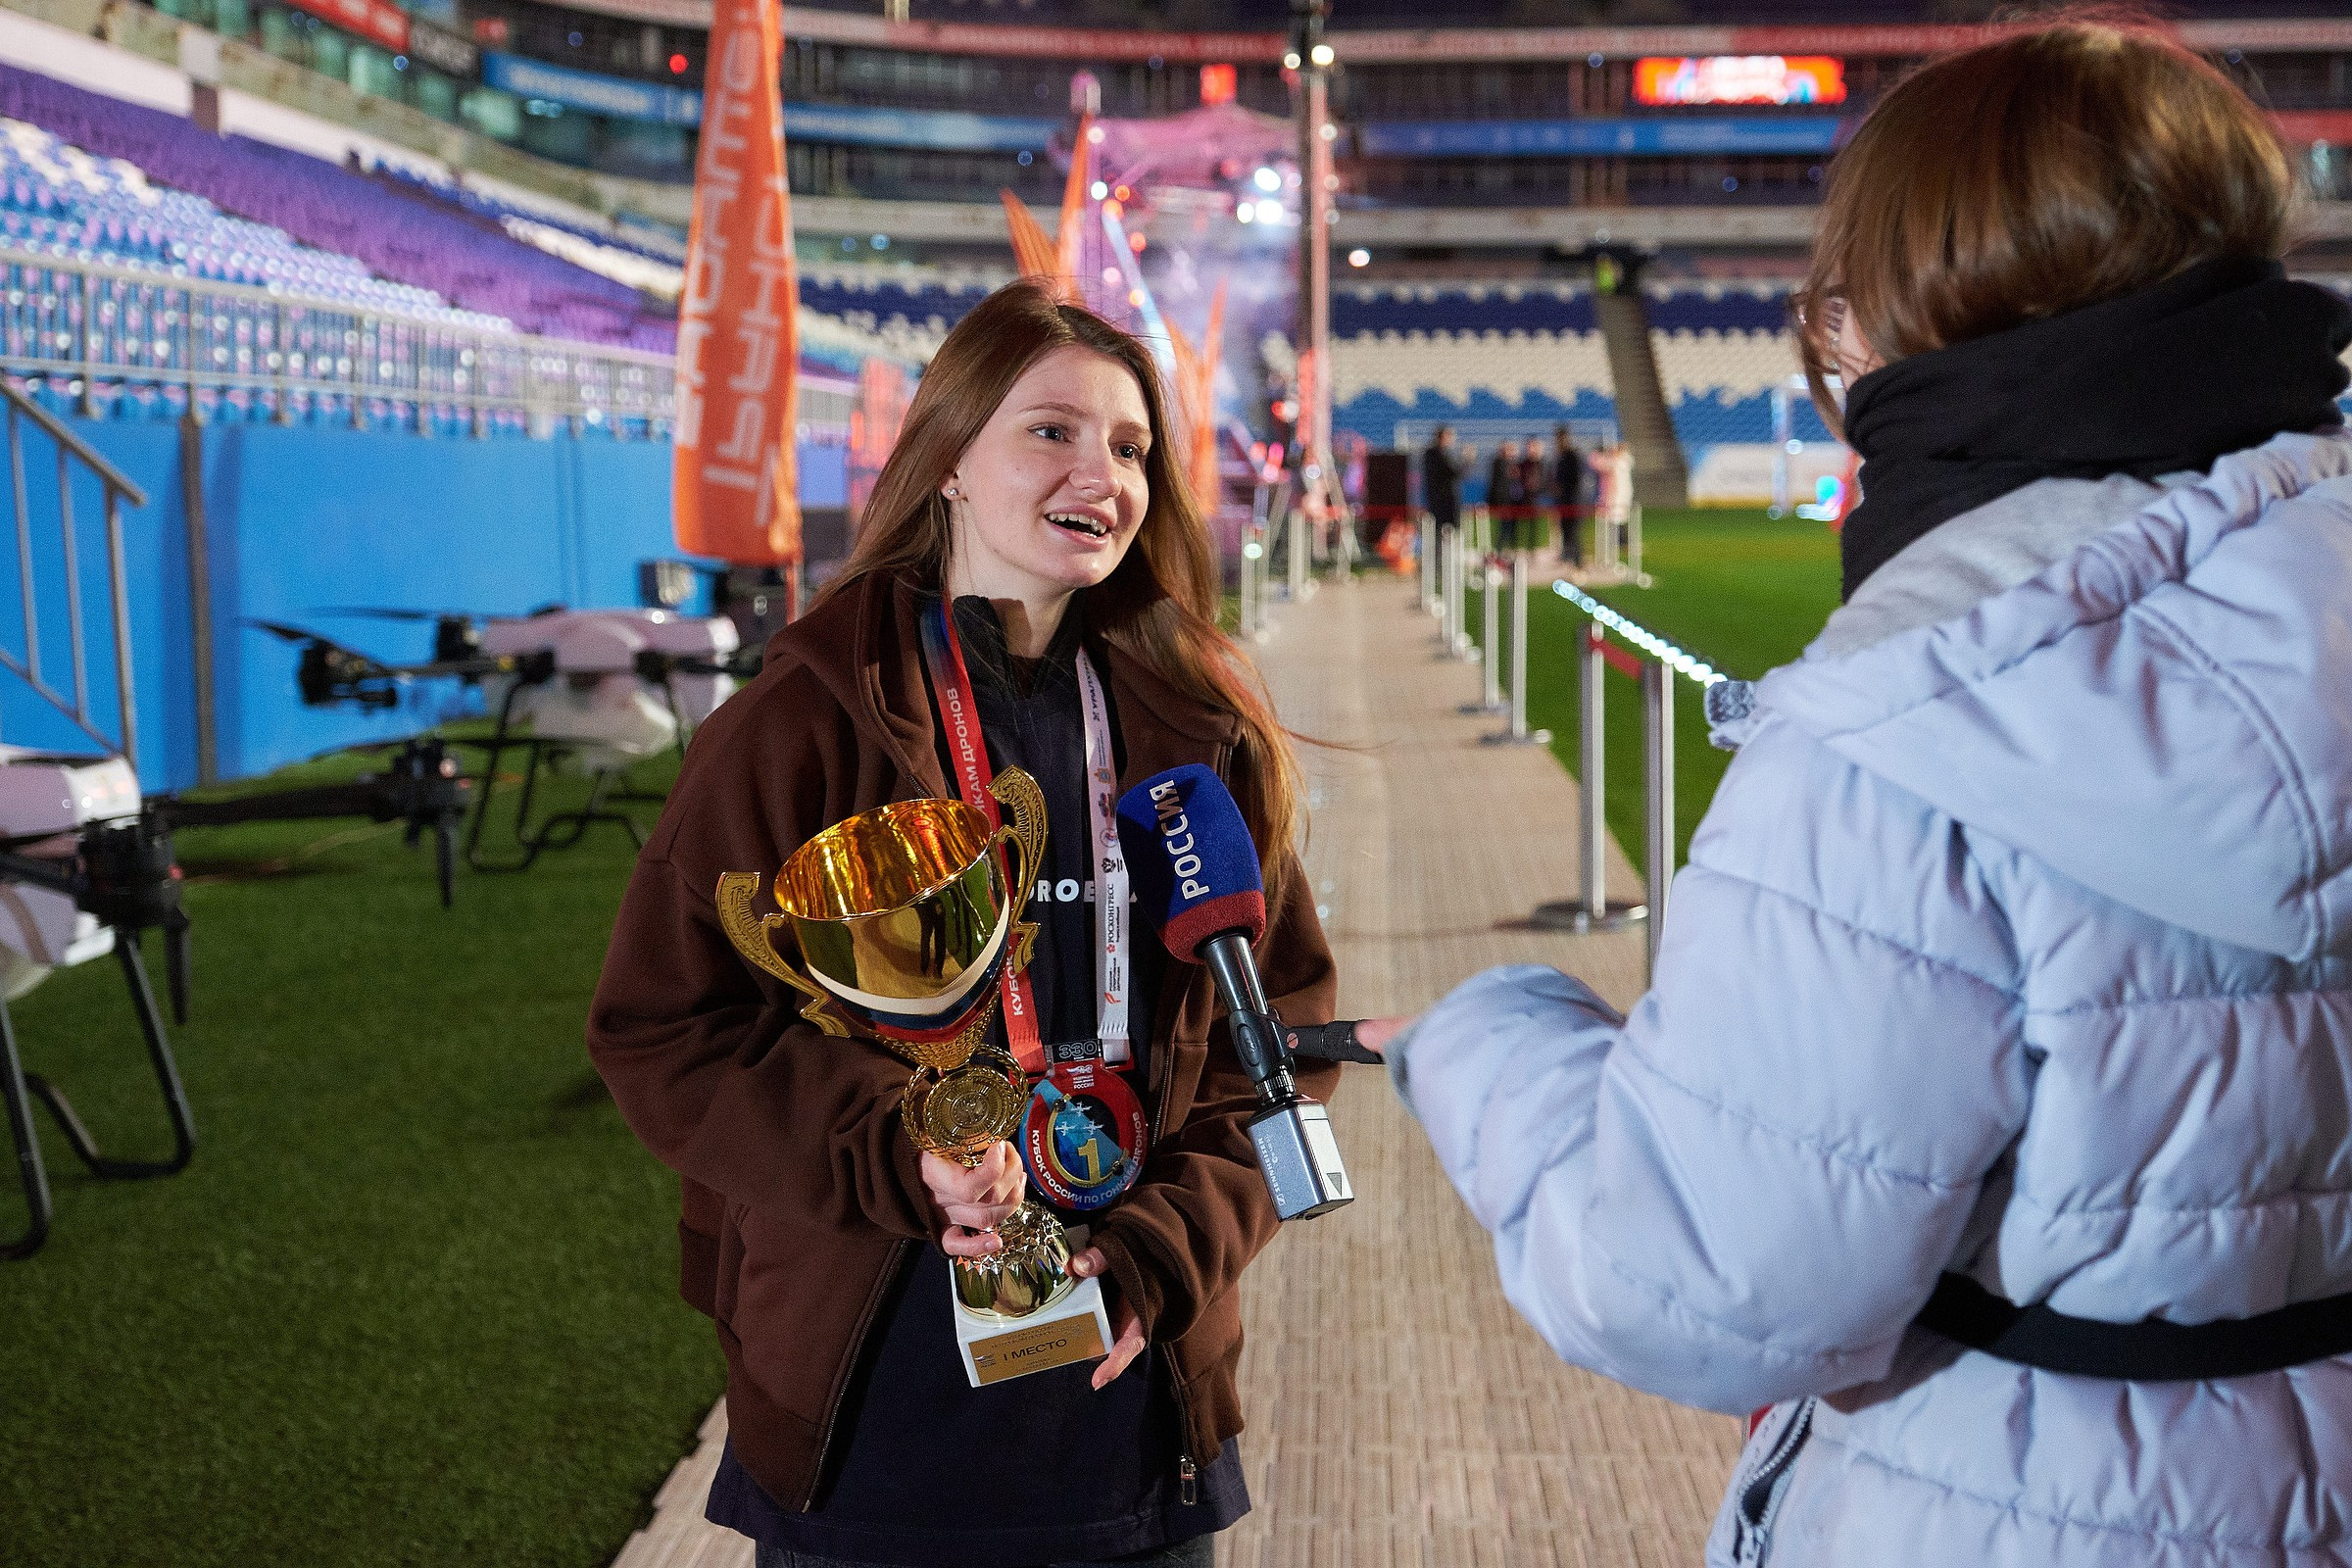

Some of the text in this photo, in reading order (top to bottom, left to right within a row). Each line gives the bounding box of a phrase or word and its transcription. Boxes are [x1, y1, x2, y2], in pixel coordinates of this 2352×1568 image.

[947, 687, 985, 810] КАМ ДРОНОВ
[1149, 779, 1210, 901] РОССИЯ
[1005, 954, 1023, 1016] КУБОК
[1058, 1040, 1098, 1059] 330
[1032, 1111, 1143, 1203] КУБОК РОССИИ ПО ГОНКАМ ДРОНОВ
[1078, 1138, 1101, 1183] 1
[1257, 1137, 1281, 1194] SENNHEISER
[1011, 1339, 1067, 1359] МЕСТО
